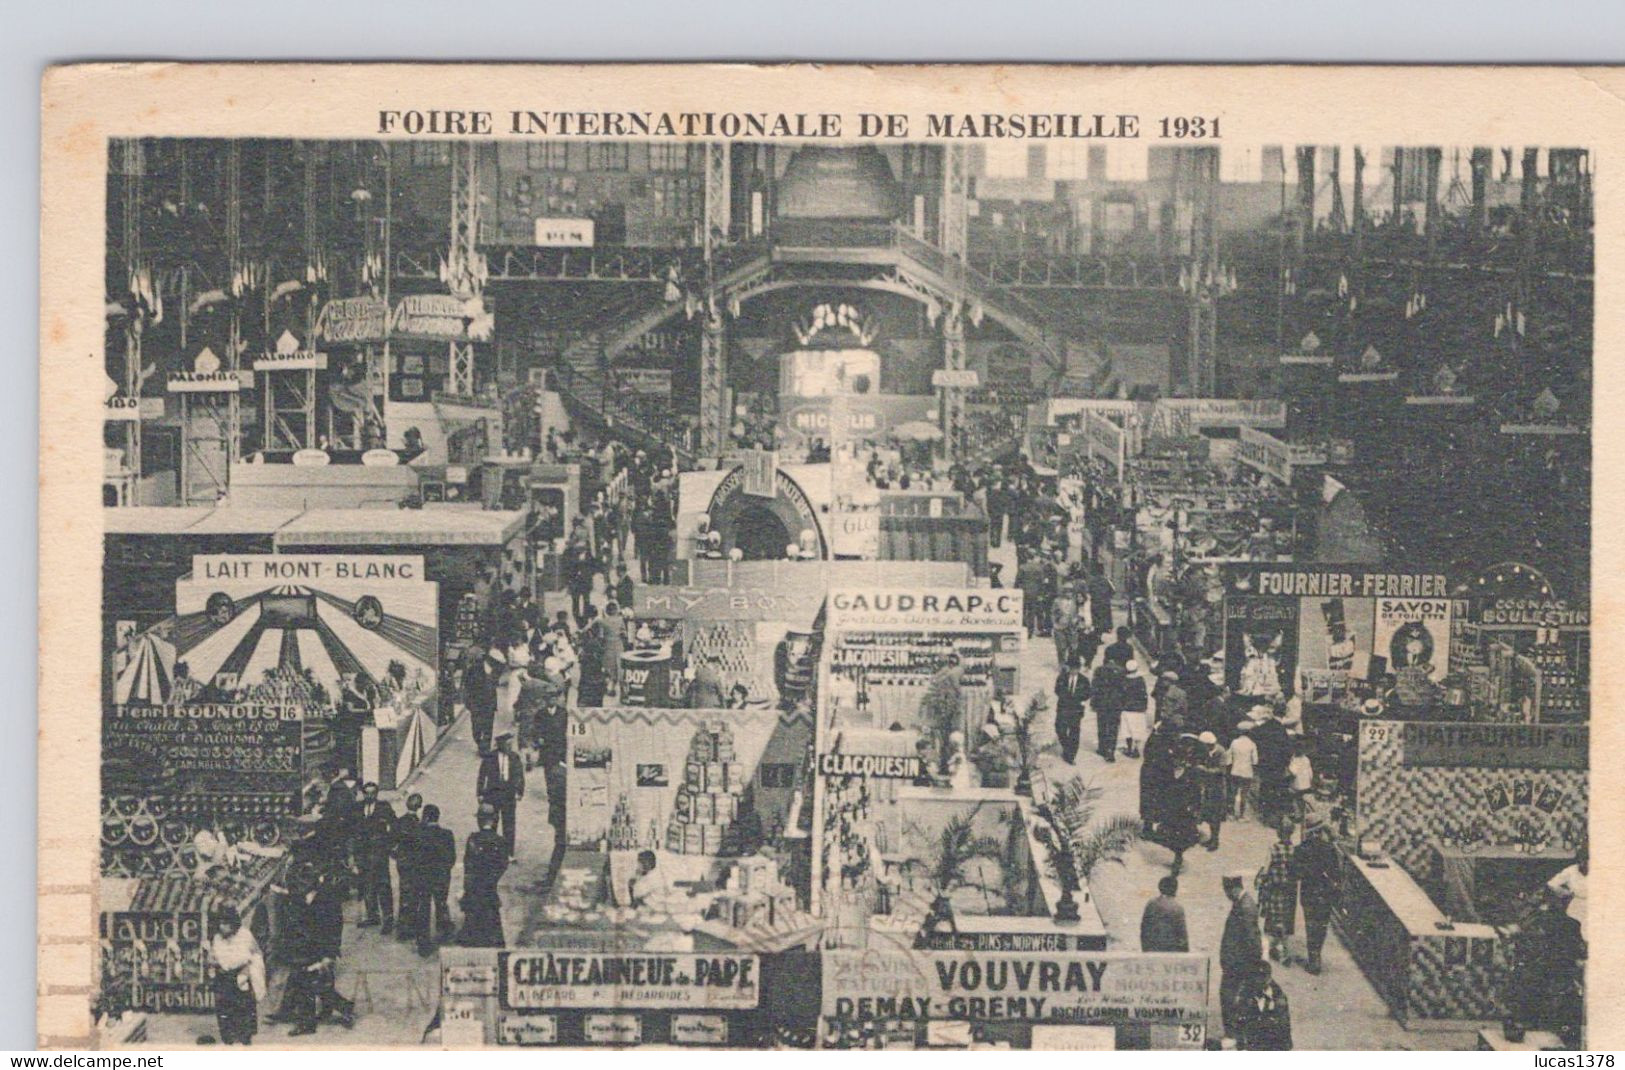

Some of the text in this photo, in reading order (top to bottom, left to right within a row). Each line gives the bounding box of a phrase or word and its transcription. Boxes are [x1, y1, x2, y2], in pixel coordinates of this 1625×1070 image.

[377, 110, 1223, 139] FOIRE INTERNATIONALE DE MARSEILLE 1931
[206, 561, 414, 579] LAIT MONT-BLANC
[646, 596, 704, 610] MY
[834, 593, 983, 613] GAUDRAP
[1381, 601, 1447, 613] SAVON
[1495, 599, 1568, 610] COGNAC
[1483, 610, 1588, 624] BOULESTIN
[830, 650, 910, 667] CLACQUESIN
[625, 669, 649, 684] BOY
[283, 707, 296, 719] 16
[572, 723, 586, 735] 18
[822, 755, 920, 777] CLACQUESIN
[694, 958, 754, 988] PAPE
[935, 960, 1107, 991] VOUVRAY
[1181, 1023, 1201, 1042] 32
